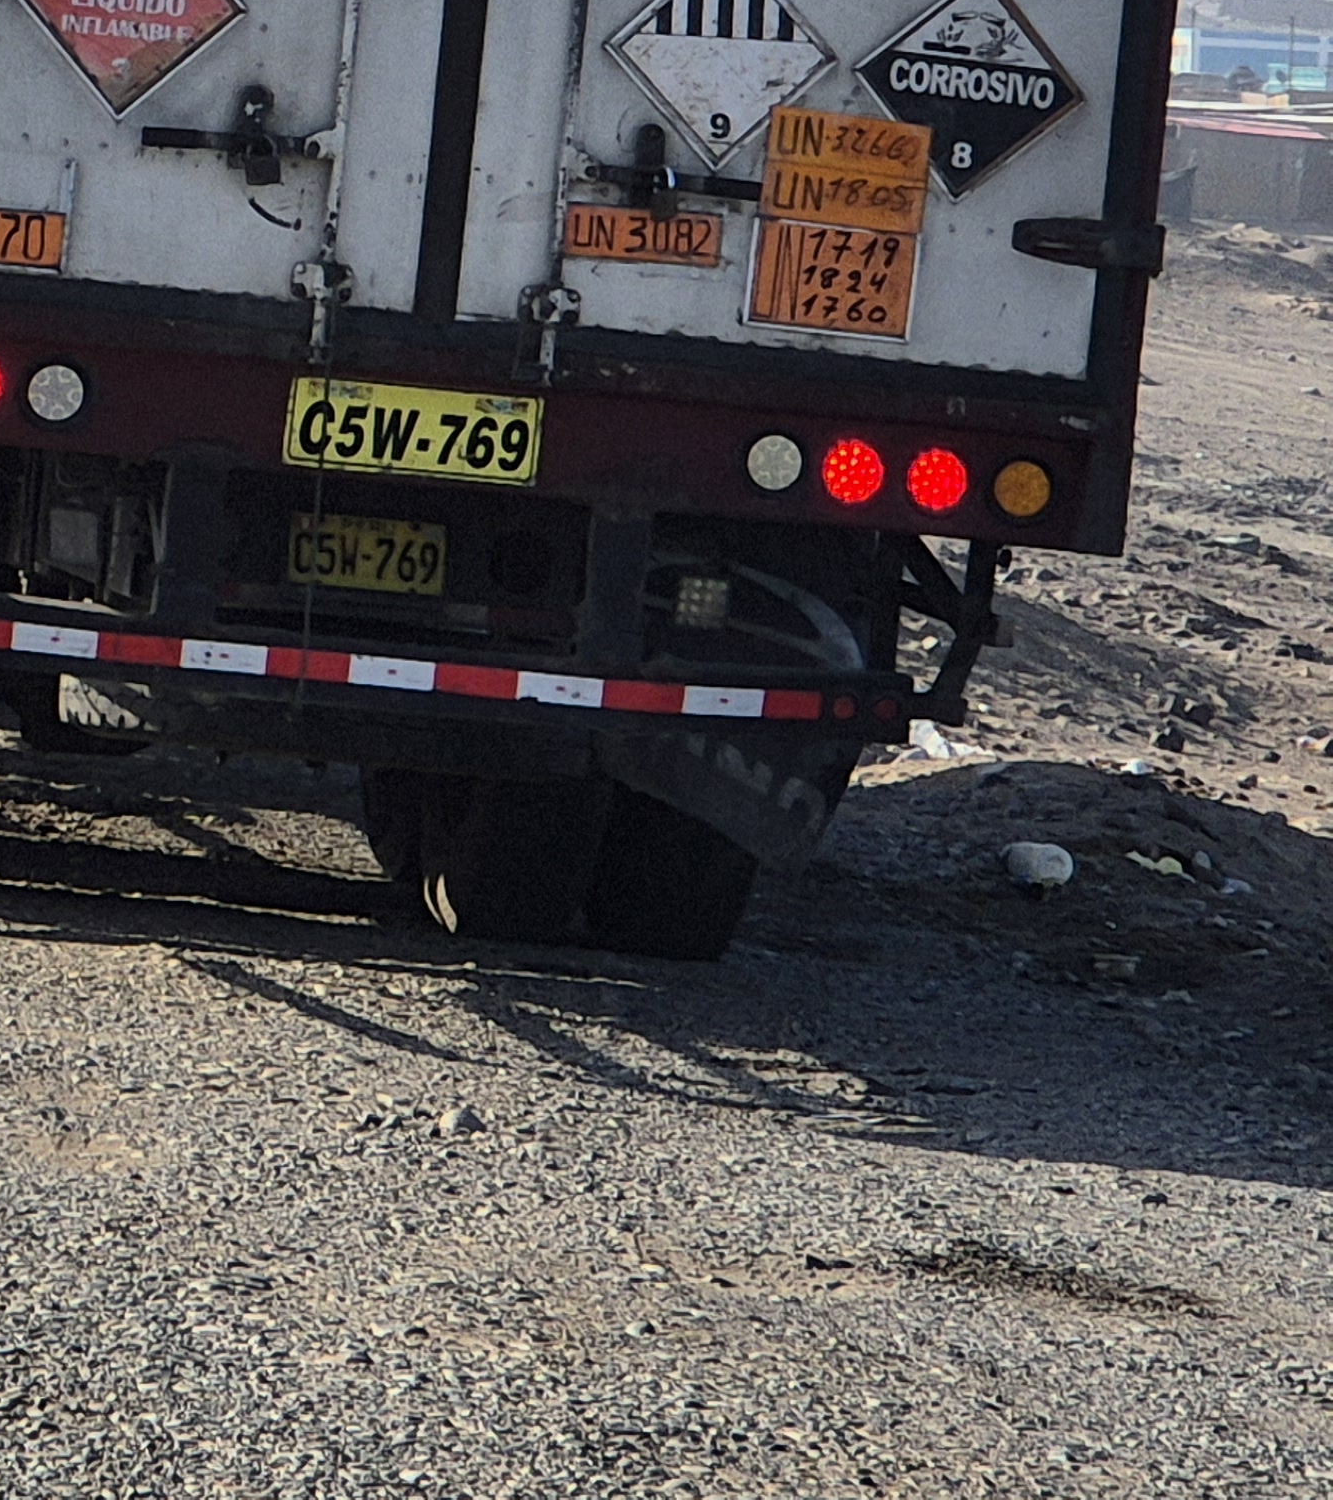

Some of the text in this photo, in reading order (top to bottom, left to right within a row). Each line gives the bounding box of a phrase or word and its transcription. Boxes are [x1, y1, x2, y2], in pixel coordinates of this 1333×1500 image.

[889, 58, 1055, 109] CORROSIVO
[709, 112, 731, 139] 9
[951, 141, 973, 169] 8
[572, 212, 713, 257] UN 3082
[808, 229, 901, 269] 1719
[802, 265, 888, 294] 1824
[801, 295, 888, 323] 1760
[298, 399, 530, 472] C5W-769
[293, 529, 440, 586] C5W-769
